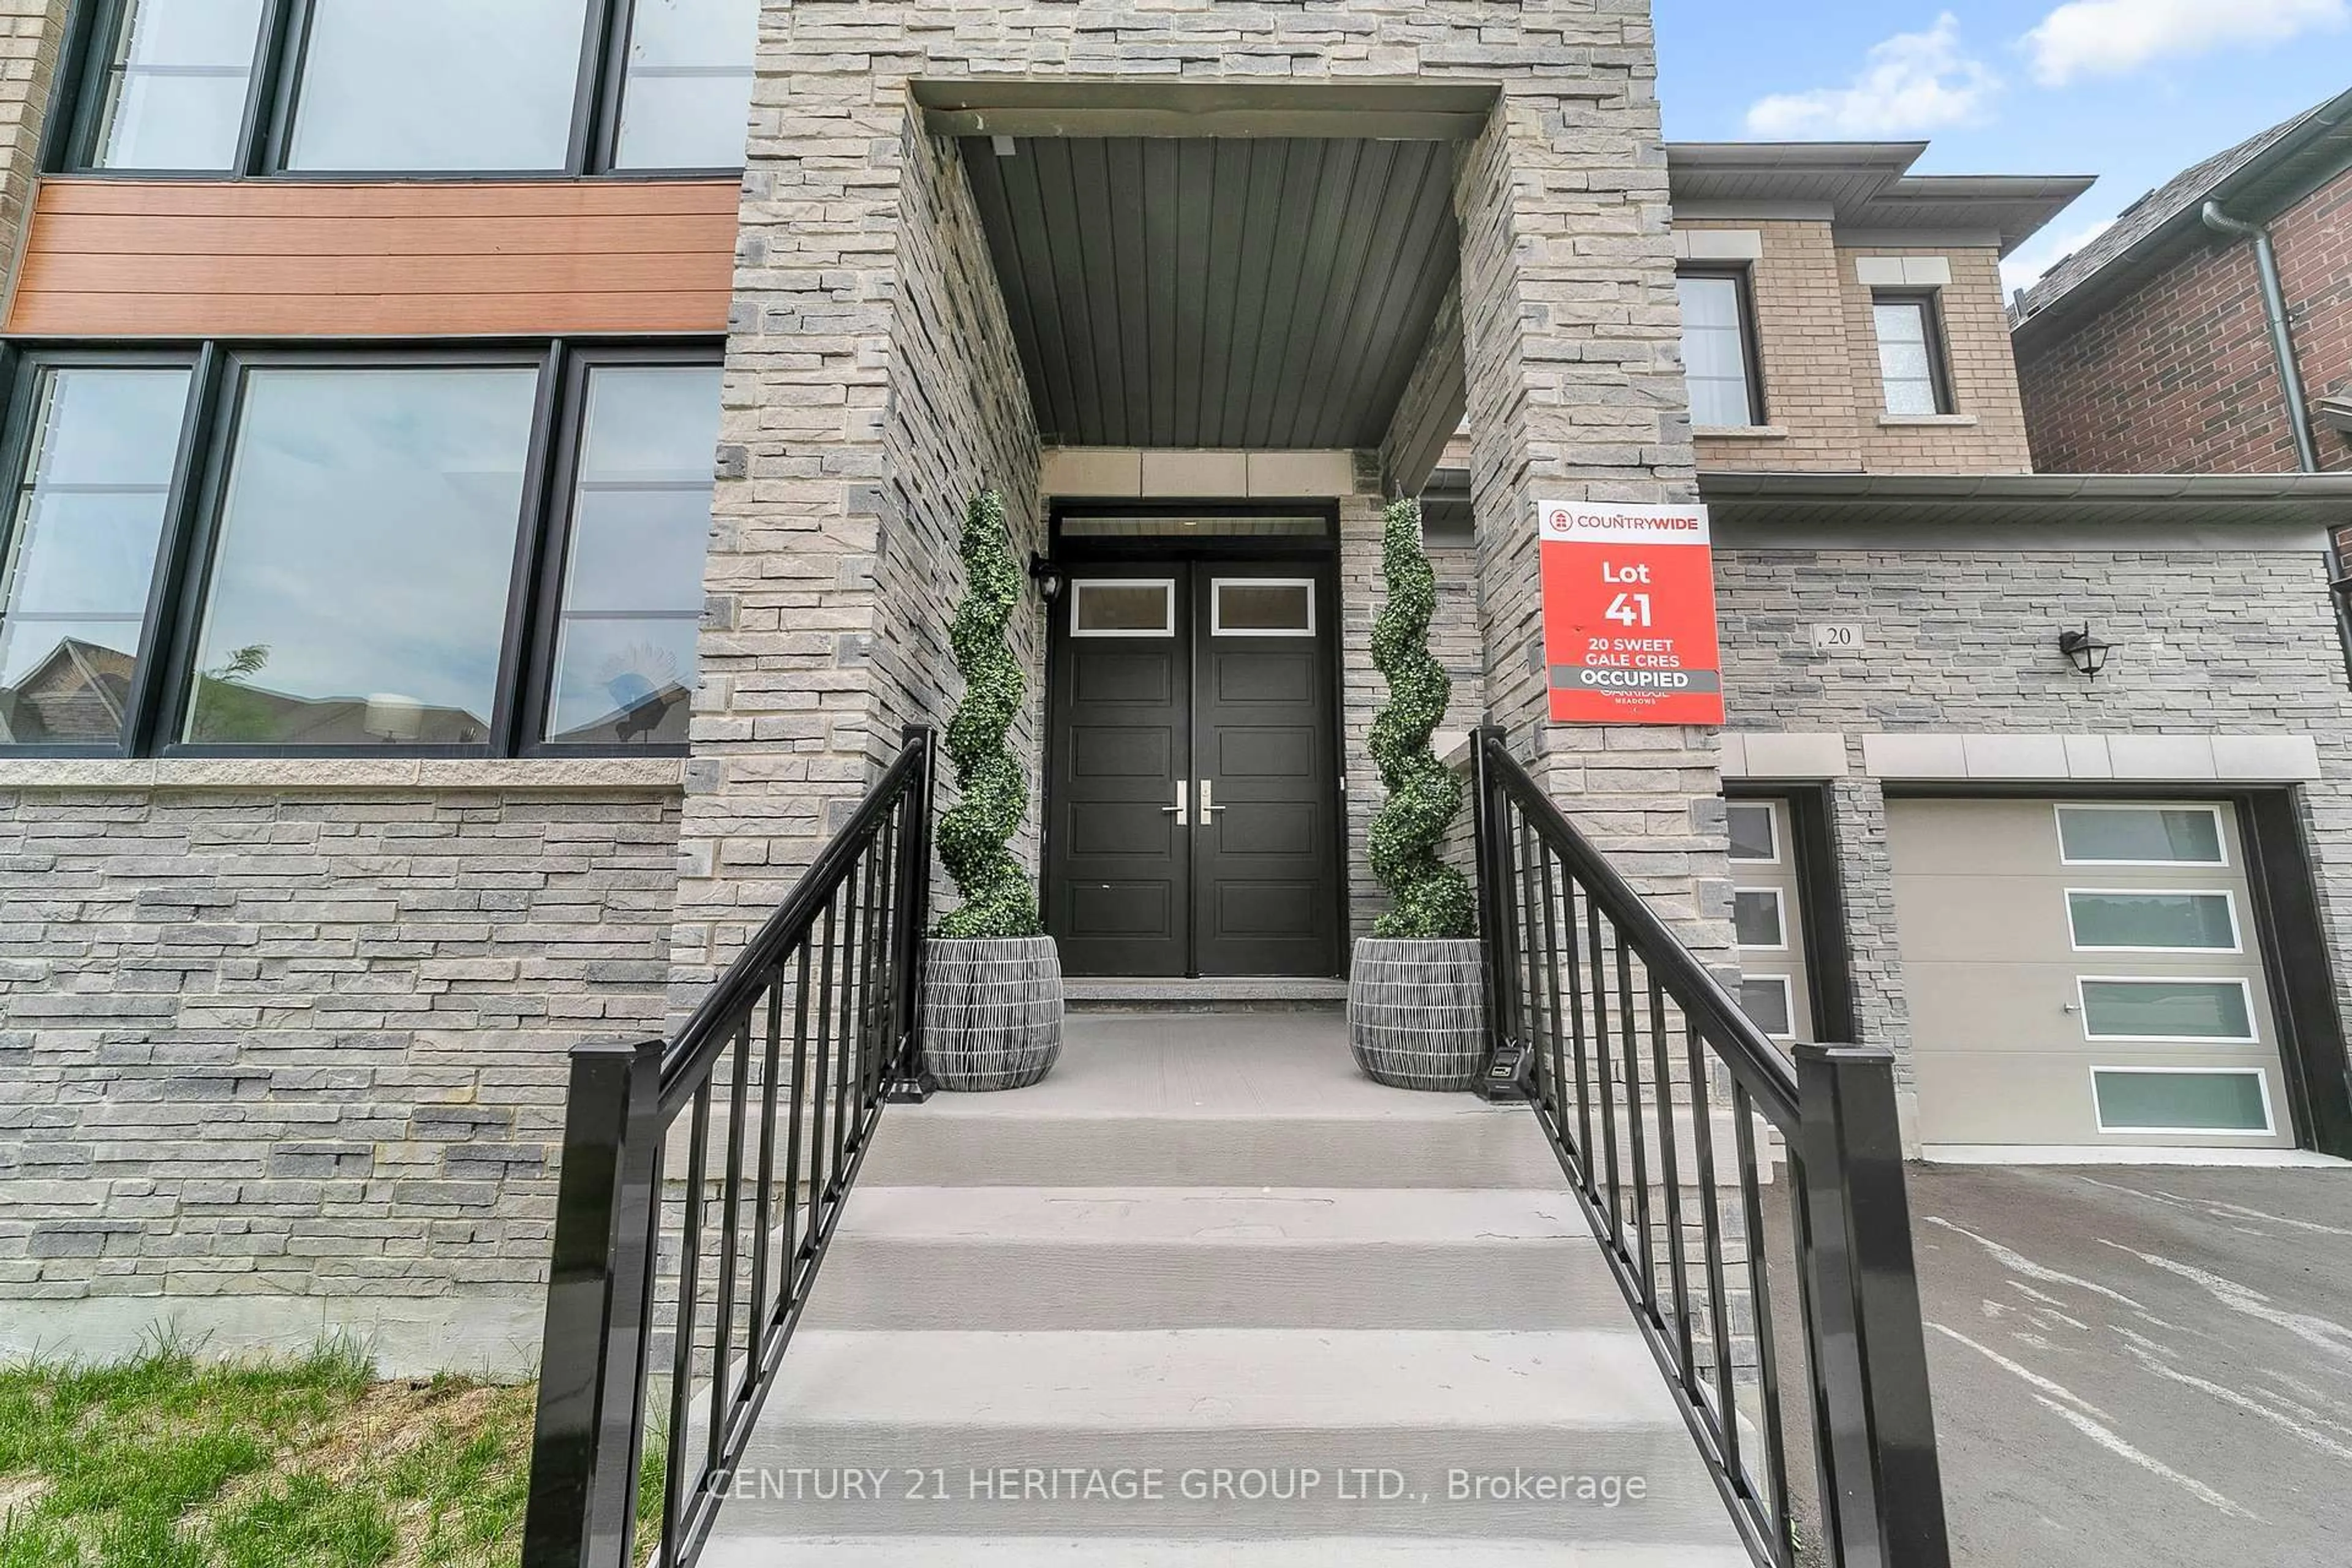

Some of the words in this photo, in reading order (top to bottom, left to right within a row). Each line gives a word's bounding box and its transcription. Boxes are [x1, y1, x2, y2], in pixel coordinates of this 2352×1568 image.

[1577, 515, 1698, 530] COUNTRYWIDE
[1602, 561, 1651, 584] Lot
[1604, 592, 1652, 627] 41
[1588, 638, 1610, 651] 20
[1613, 639, 1674, 652] SWEET
[1826, 627, 1850, 645] 20
[1585, 653, 1630, 667] GALE
[1635, 654, 1680, 668] CRES
[1580, 669, 1689, 688] OCCUPIED
